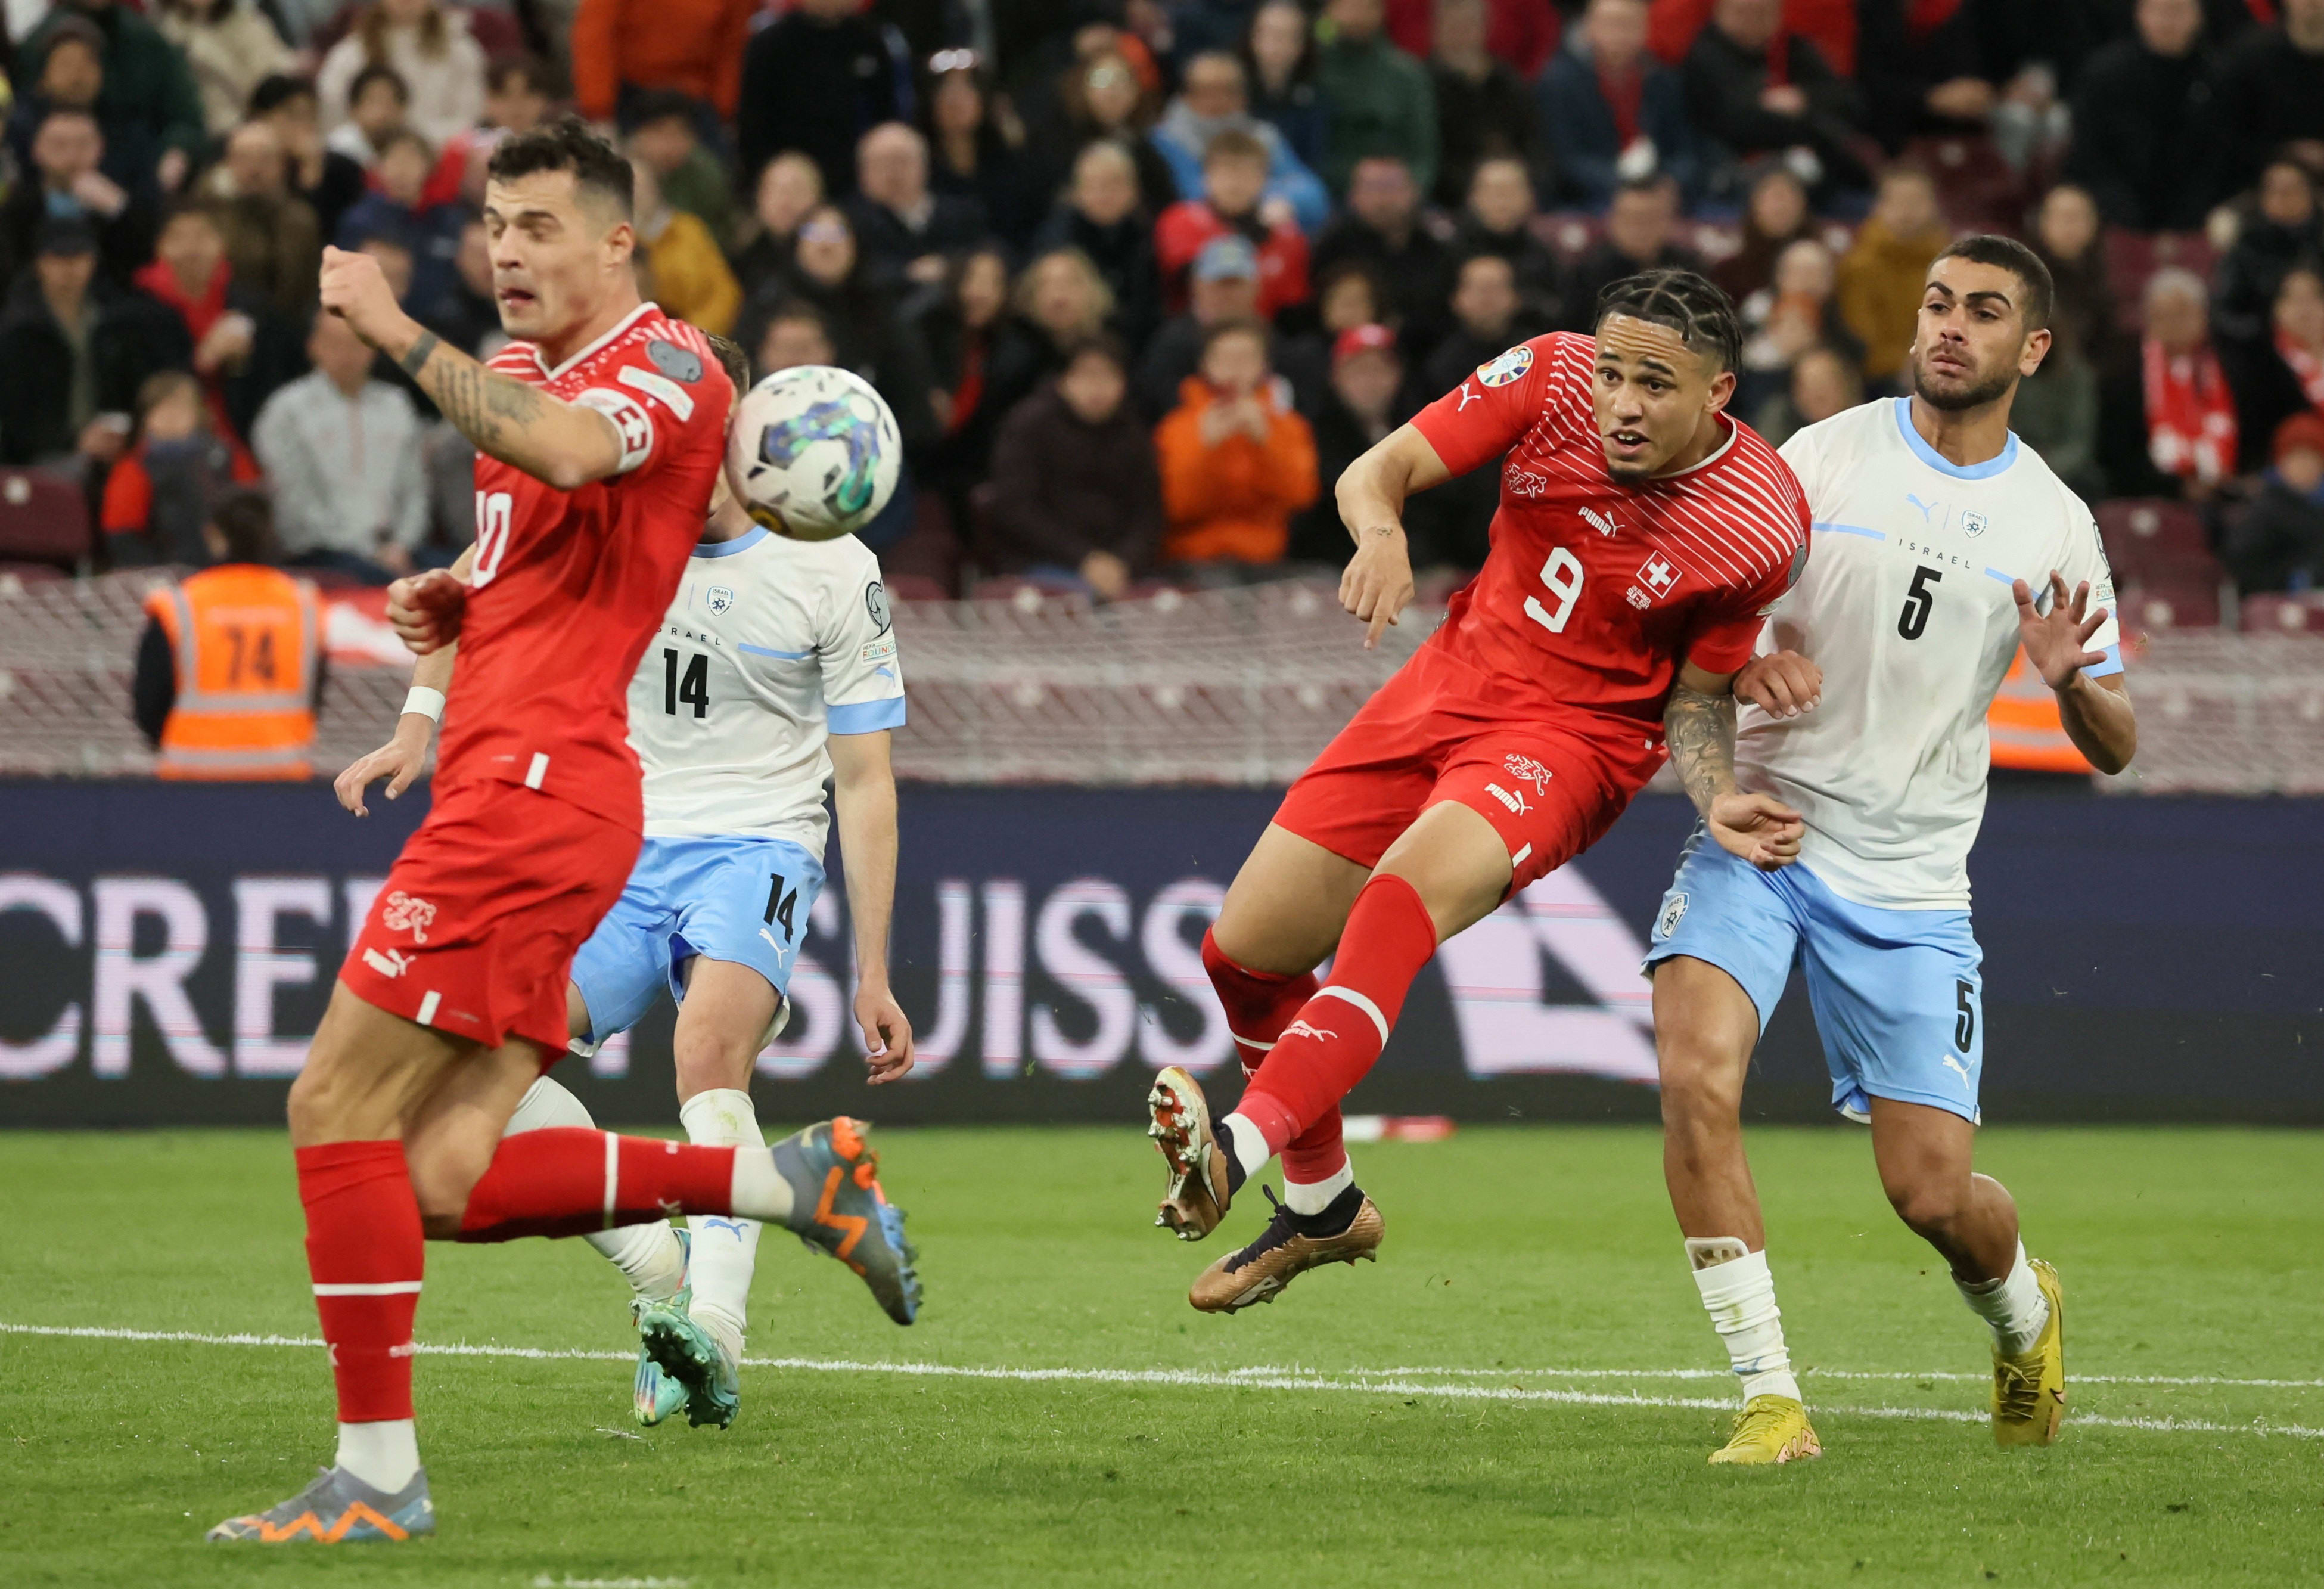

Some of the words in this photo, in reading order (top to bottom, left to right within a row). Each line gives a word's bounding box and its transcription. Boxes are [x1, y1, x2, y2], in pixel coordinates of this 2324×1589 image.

[1577, 506, 1612, 536] PUMA
[1899, 538, 1970, 569] ISRAEL
[1523, 546, 1584, 633] 9
[1897, 564, 1943, 641] 5
[224, 625, 278, 688] 74
[657, 625, 721, 645] SRAEL
[663, 648, 709, 718] 14
[1484, 782, 1520, 813] PUMA
[762, 872, 798, 944] 14
[754, 876, 1242, 1079] SUISS
[1955, 979, 1975, 1054] 5
